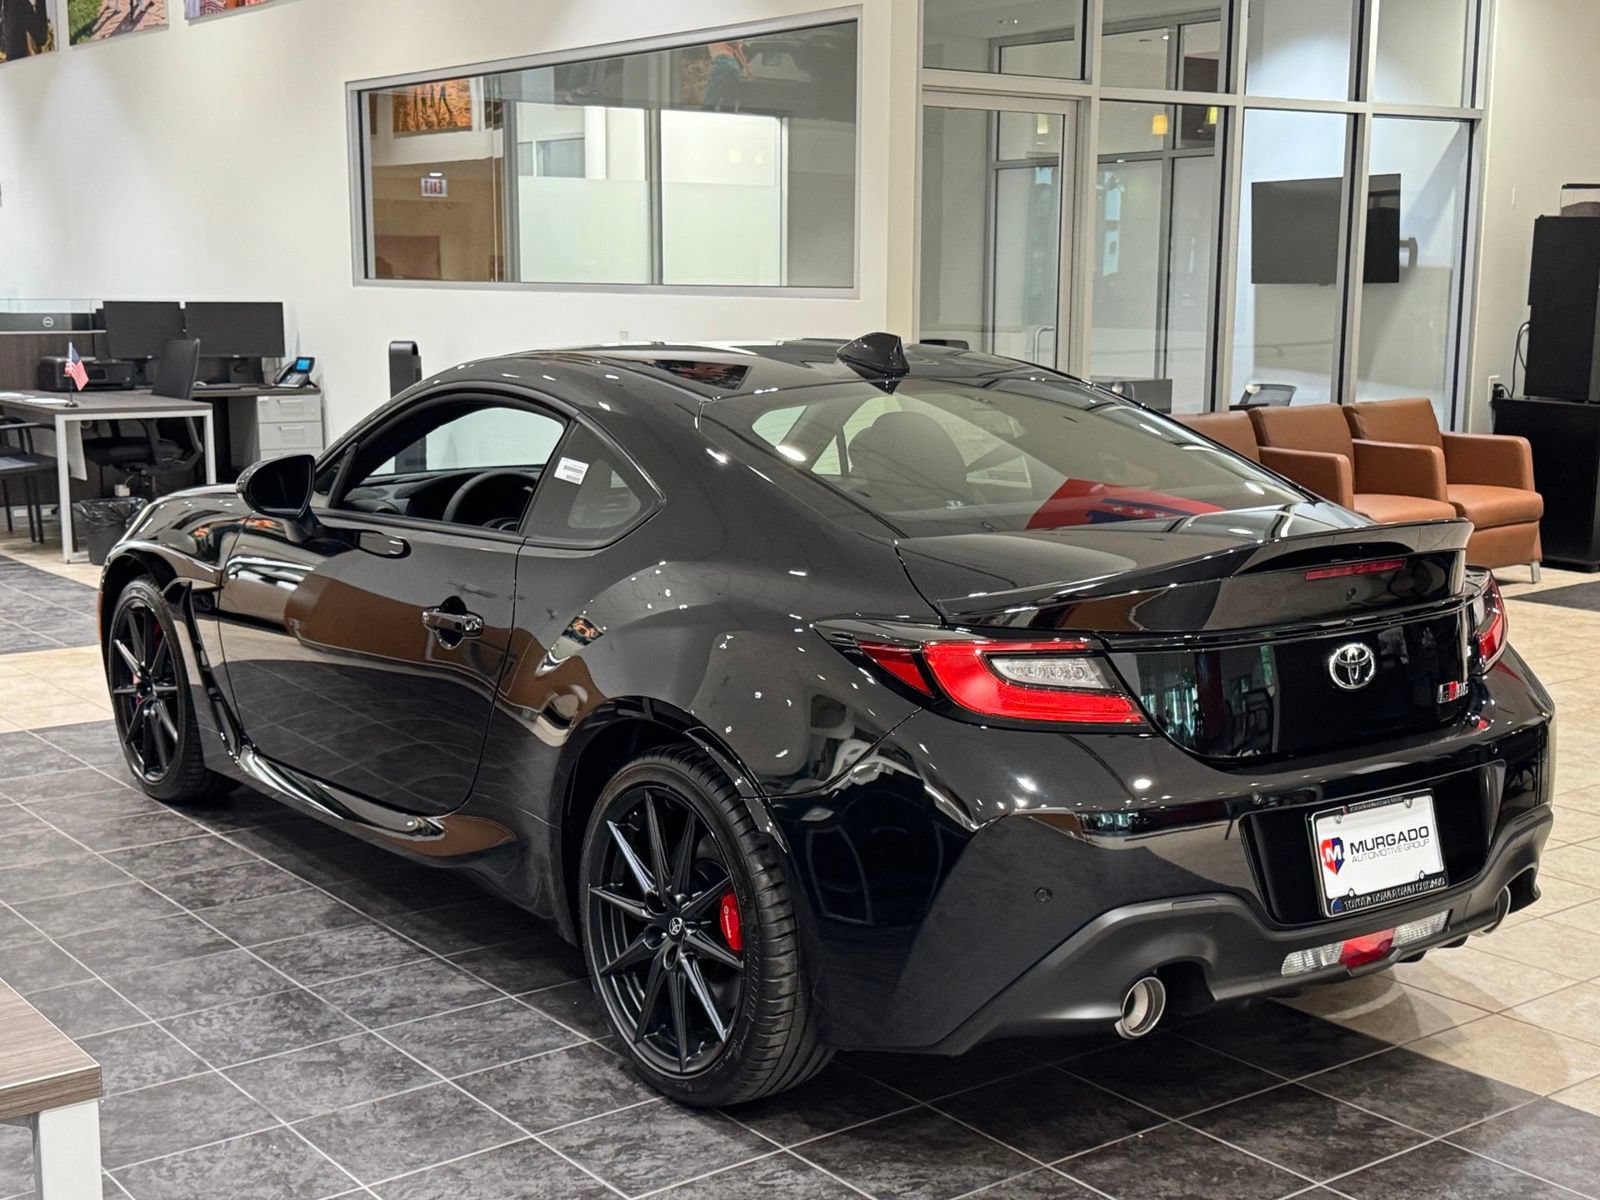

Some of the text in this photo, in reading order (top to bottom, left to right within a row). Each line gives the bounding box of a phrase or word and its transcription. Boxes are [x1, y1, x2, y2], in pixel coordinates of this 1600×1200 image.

[1349, 826, 1430, 855] MURGADO
[1352, 838, 1430, 863] AUTOMOTIVE GROUP
